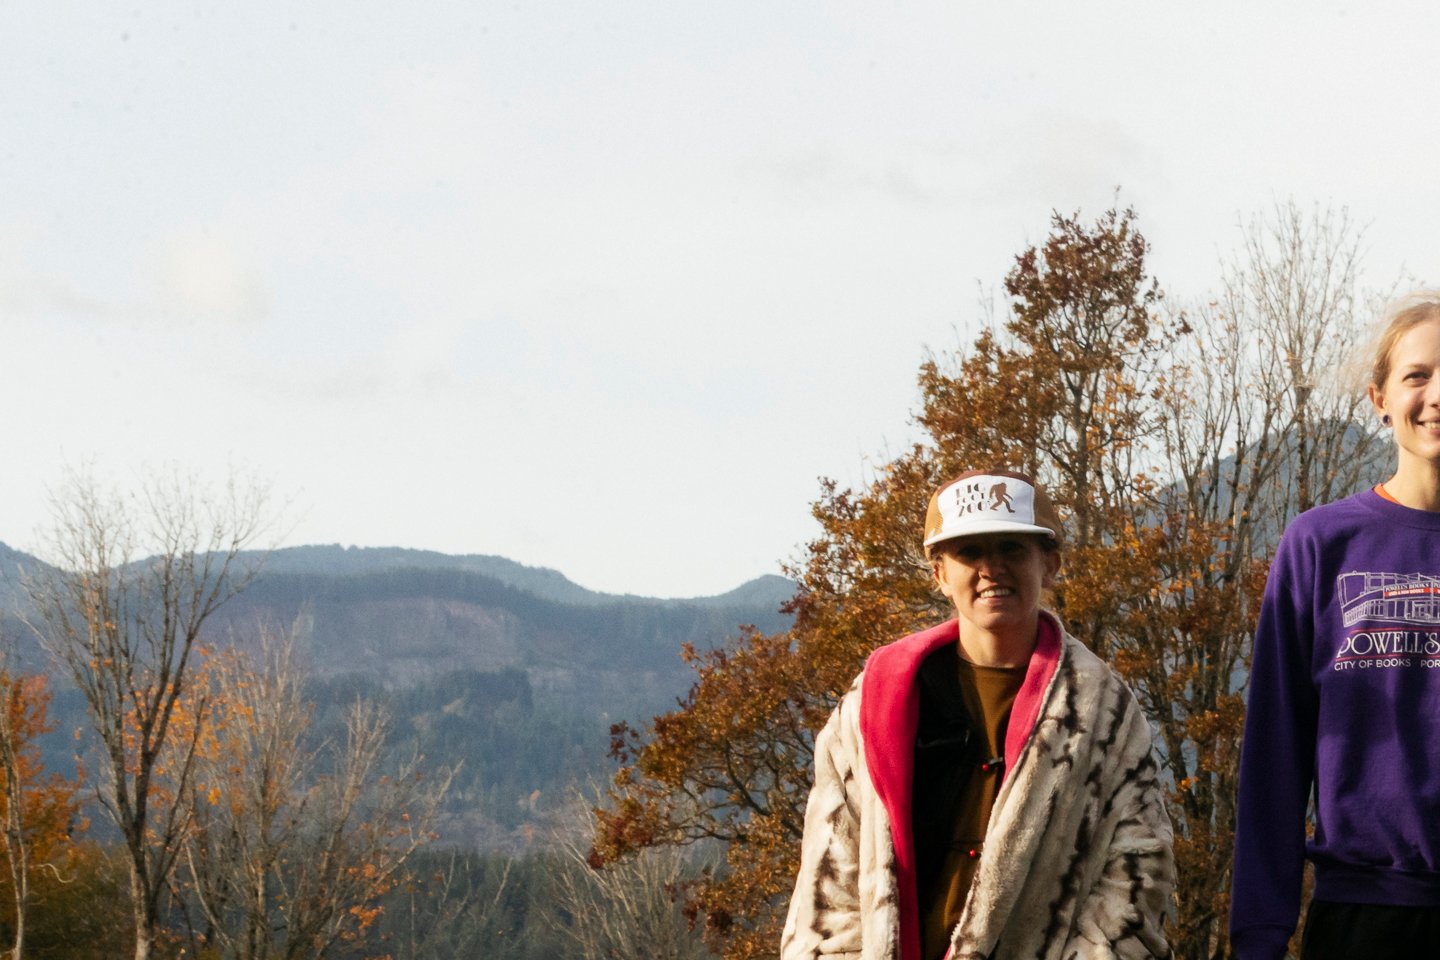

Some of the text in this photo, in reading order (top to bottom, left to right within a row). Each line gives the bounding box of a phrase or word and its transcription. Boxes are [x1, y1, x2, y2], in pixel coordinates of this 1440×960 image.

[1337, 630, 1440, 657] POWELL'S
[1334, 660, 1356, 672] CITY
[1358, 659, 1374, 669] OF
[1375, 657, 1412, 669] BOOKS
